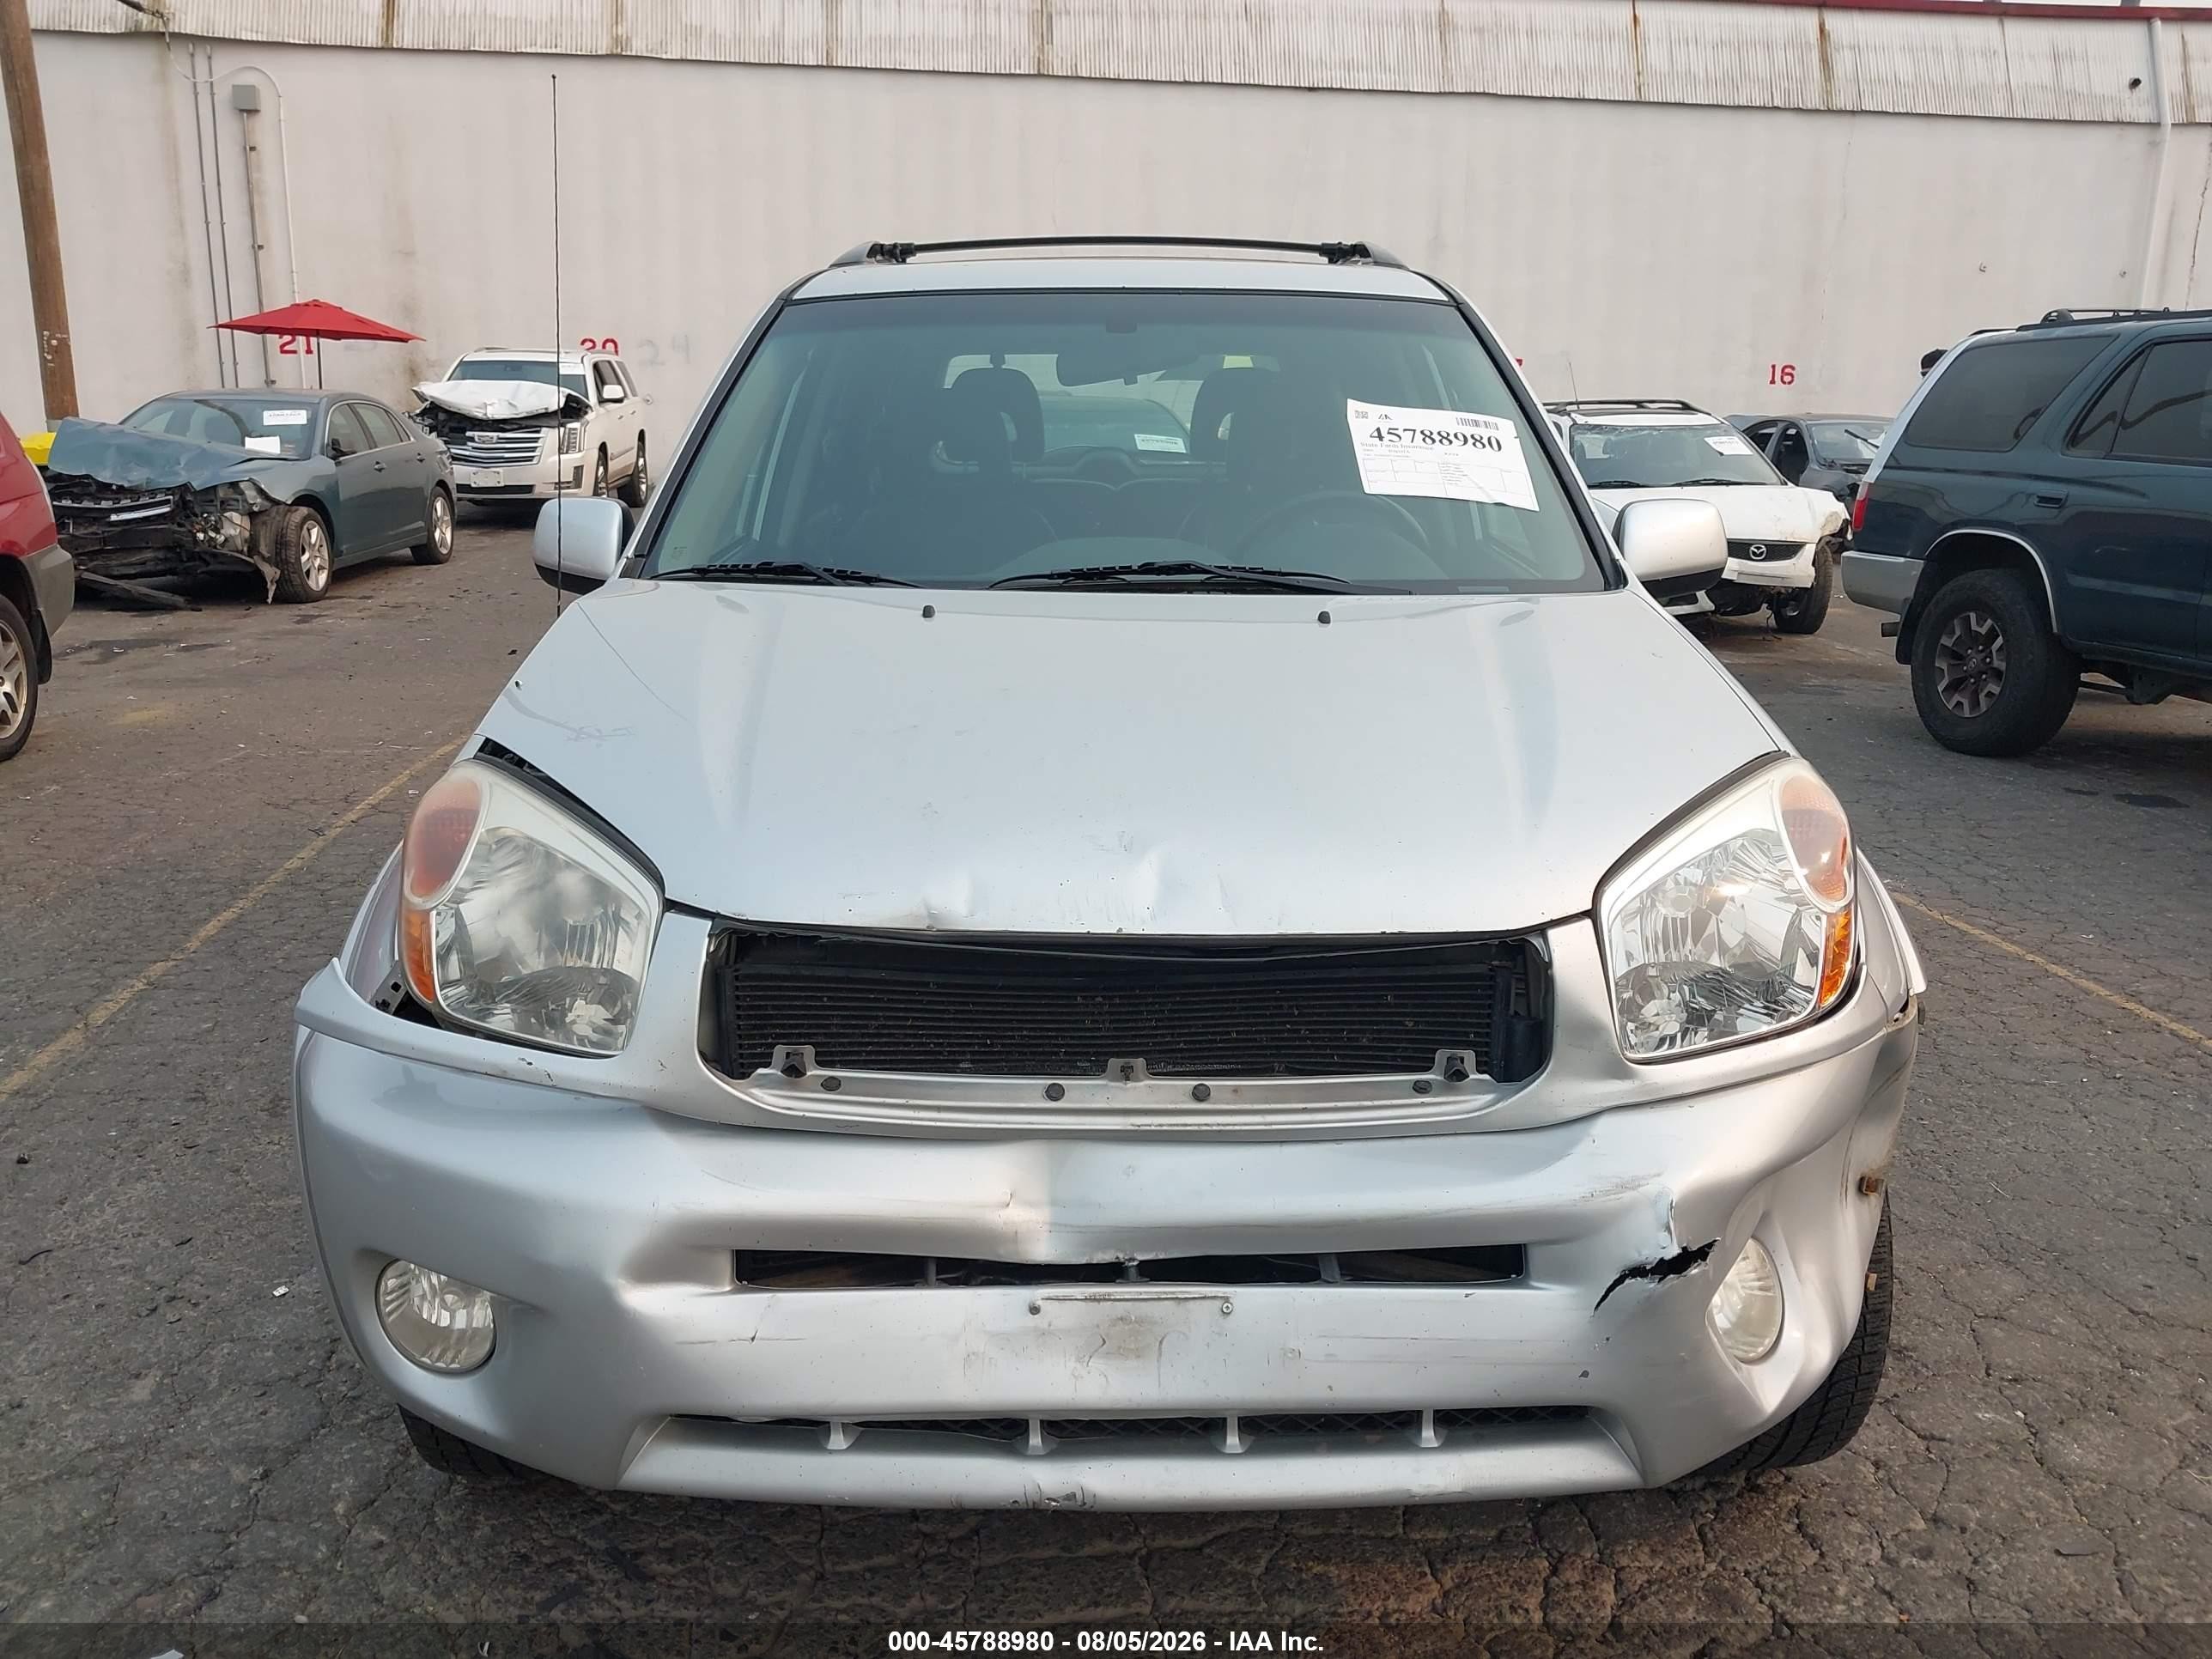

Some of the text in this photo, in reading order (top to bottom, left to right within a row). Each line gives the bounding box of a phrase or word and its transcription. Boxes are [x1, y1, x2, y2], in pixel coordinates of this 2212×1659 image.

[278, 333, 314, 355] 21
[1769, 364, 1796, 386] 16
[1369, 426, 1503, 453] 45788980
